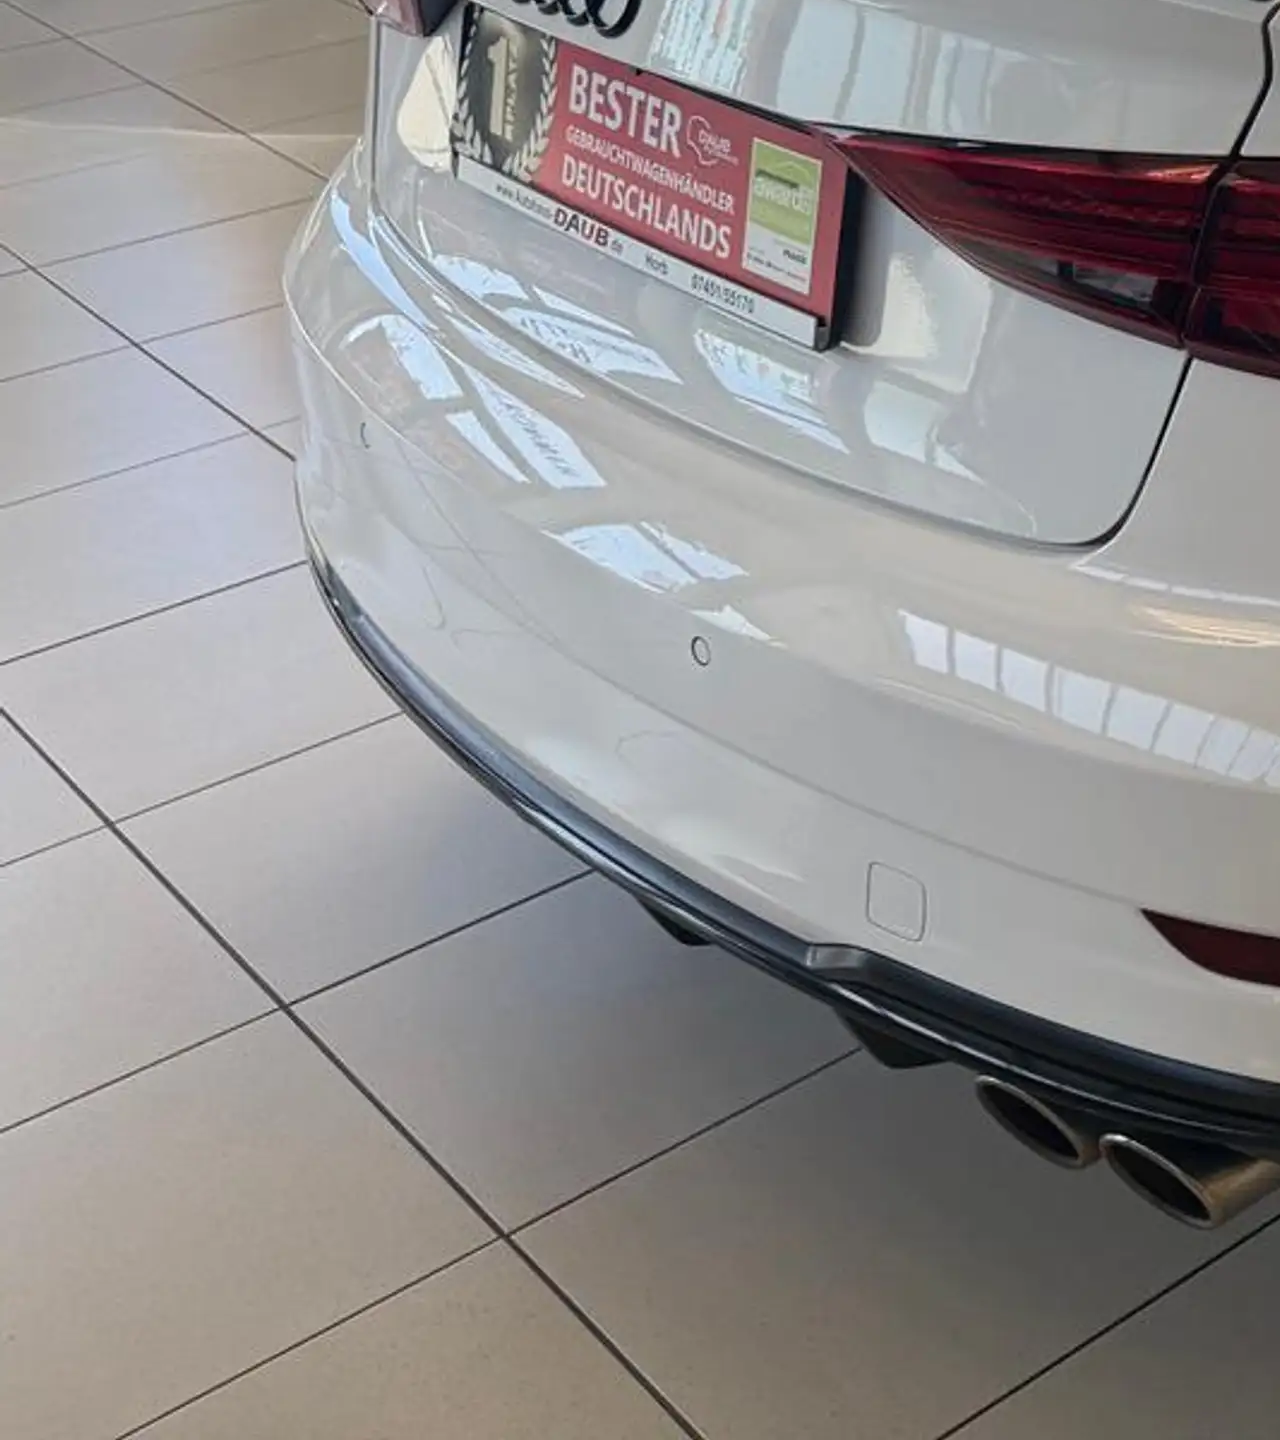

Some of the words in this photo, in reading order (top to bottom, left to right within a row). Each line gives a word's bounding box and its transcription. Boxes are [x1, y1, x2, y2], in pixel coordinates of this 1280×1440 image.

[568, 65, 683, 159] BESTER
[561, 155, 732, 260] DEUTSCHLANDS
[565, 125, 735, 215] GEBRAUCHTWAGENHÄNDLER
